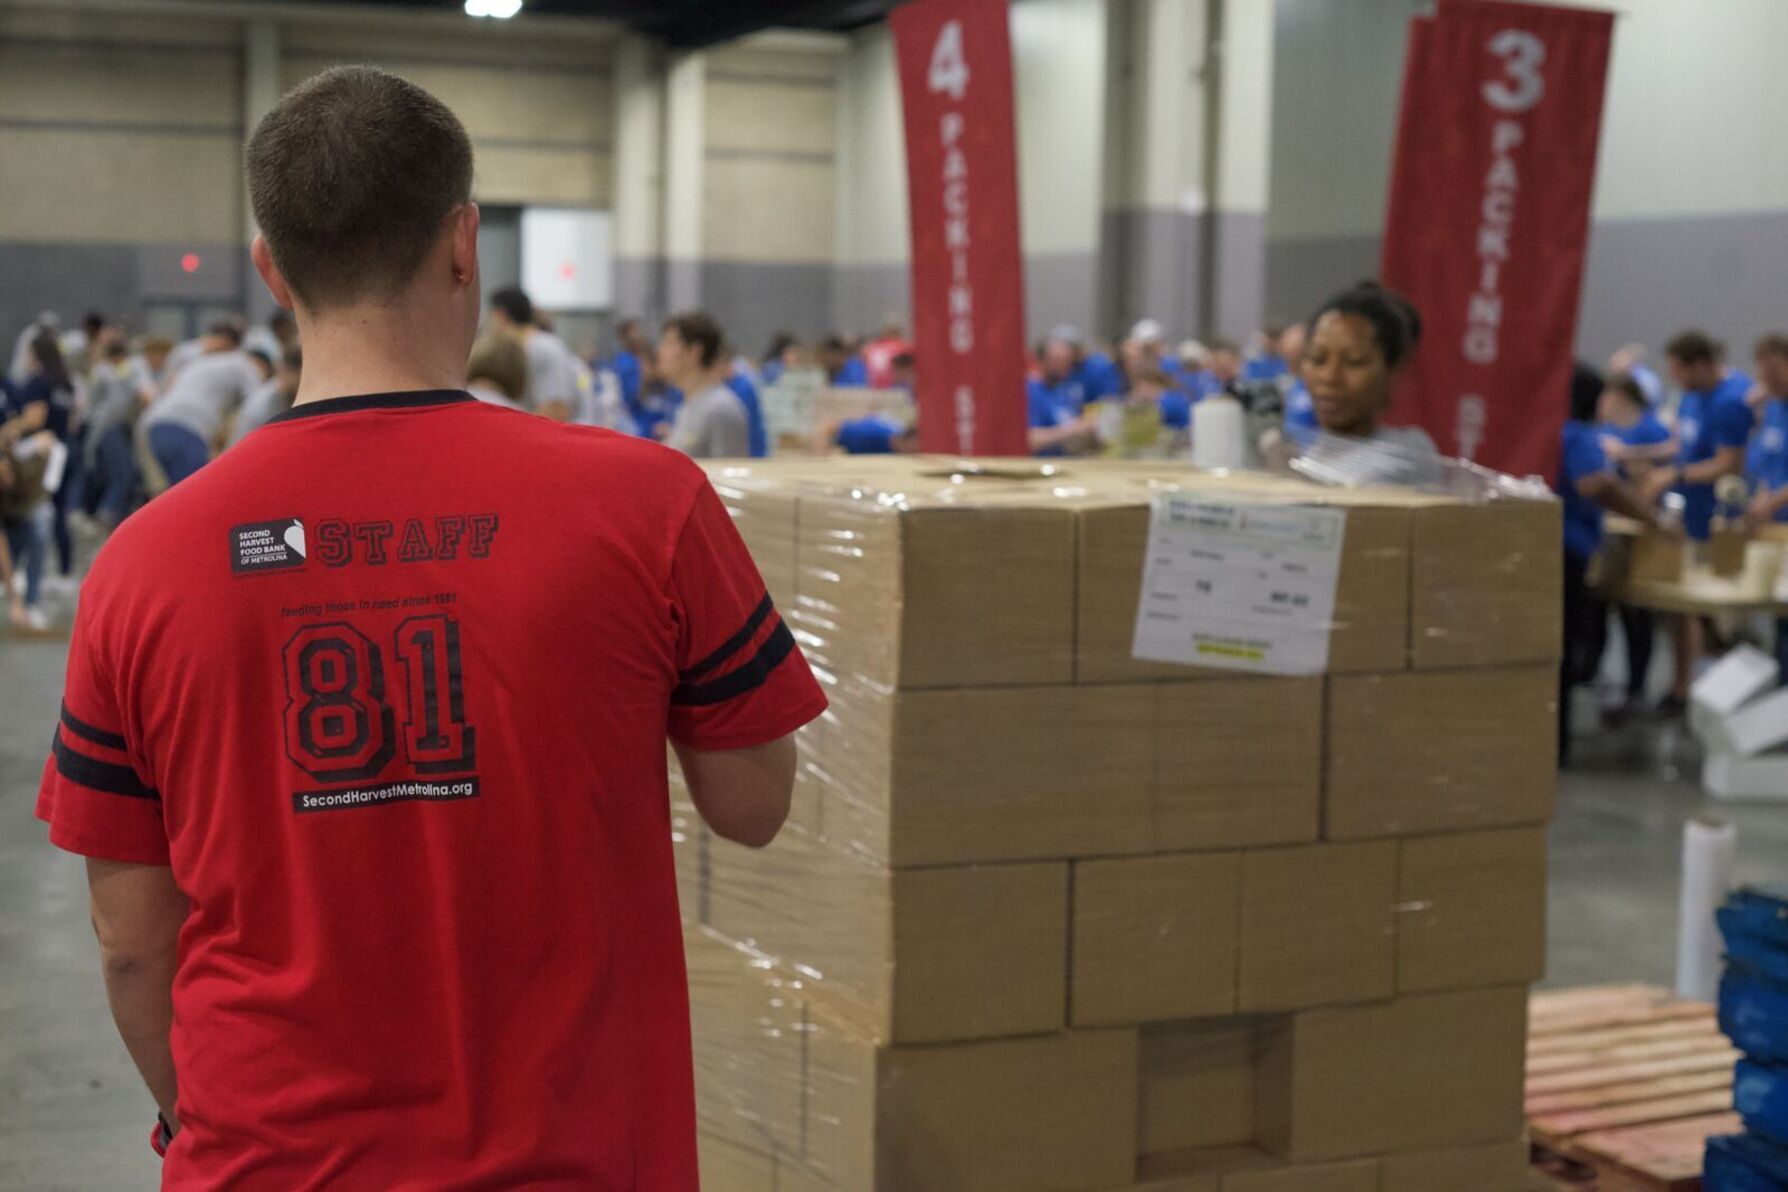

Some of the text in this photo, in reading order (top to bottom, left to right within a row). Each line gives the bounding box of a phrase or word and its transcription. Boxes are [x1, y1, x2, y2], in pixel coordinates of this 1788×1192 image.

[928, 19, 969, 98] 4
[1481, 28, 1546, 113] 3
[940, 113, 973, 354] PACKING
[1463, 119, 1524, 364] PACKING
[239, 529, 270, 540] SECOND
[240, 537, 274, 548] HARVEST
[240, 544, 286, 556] FOOD BANK
[241, 554, 287, 565] OF METROLINA
[315, 512, 498, 568] STAFF
[282, 613, 476, 784] 81
[303, 783, 473, 807] SecondHarvestMetrolina.org
